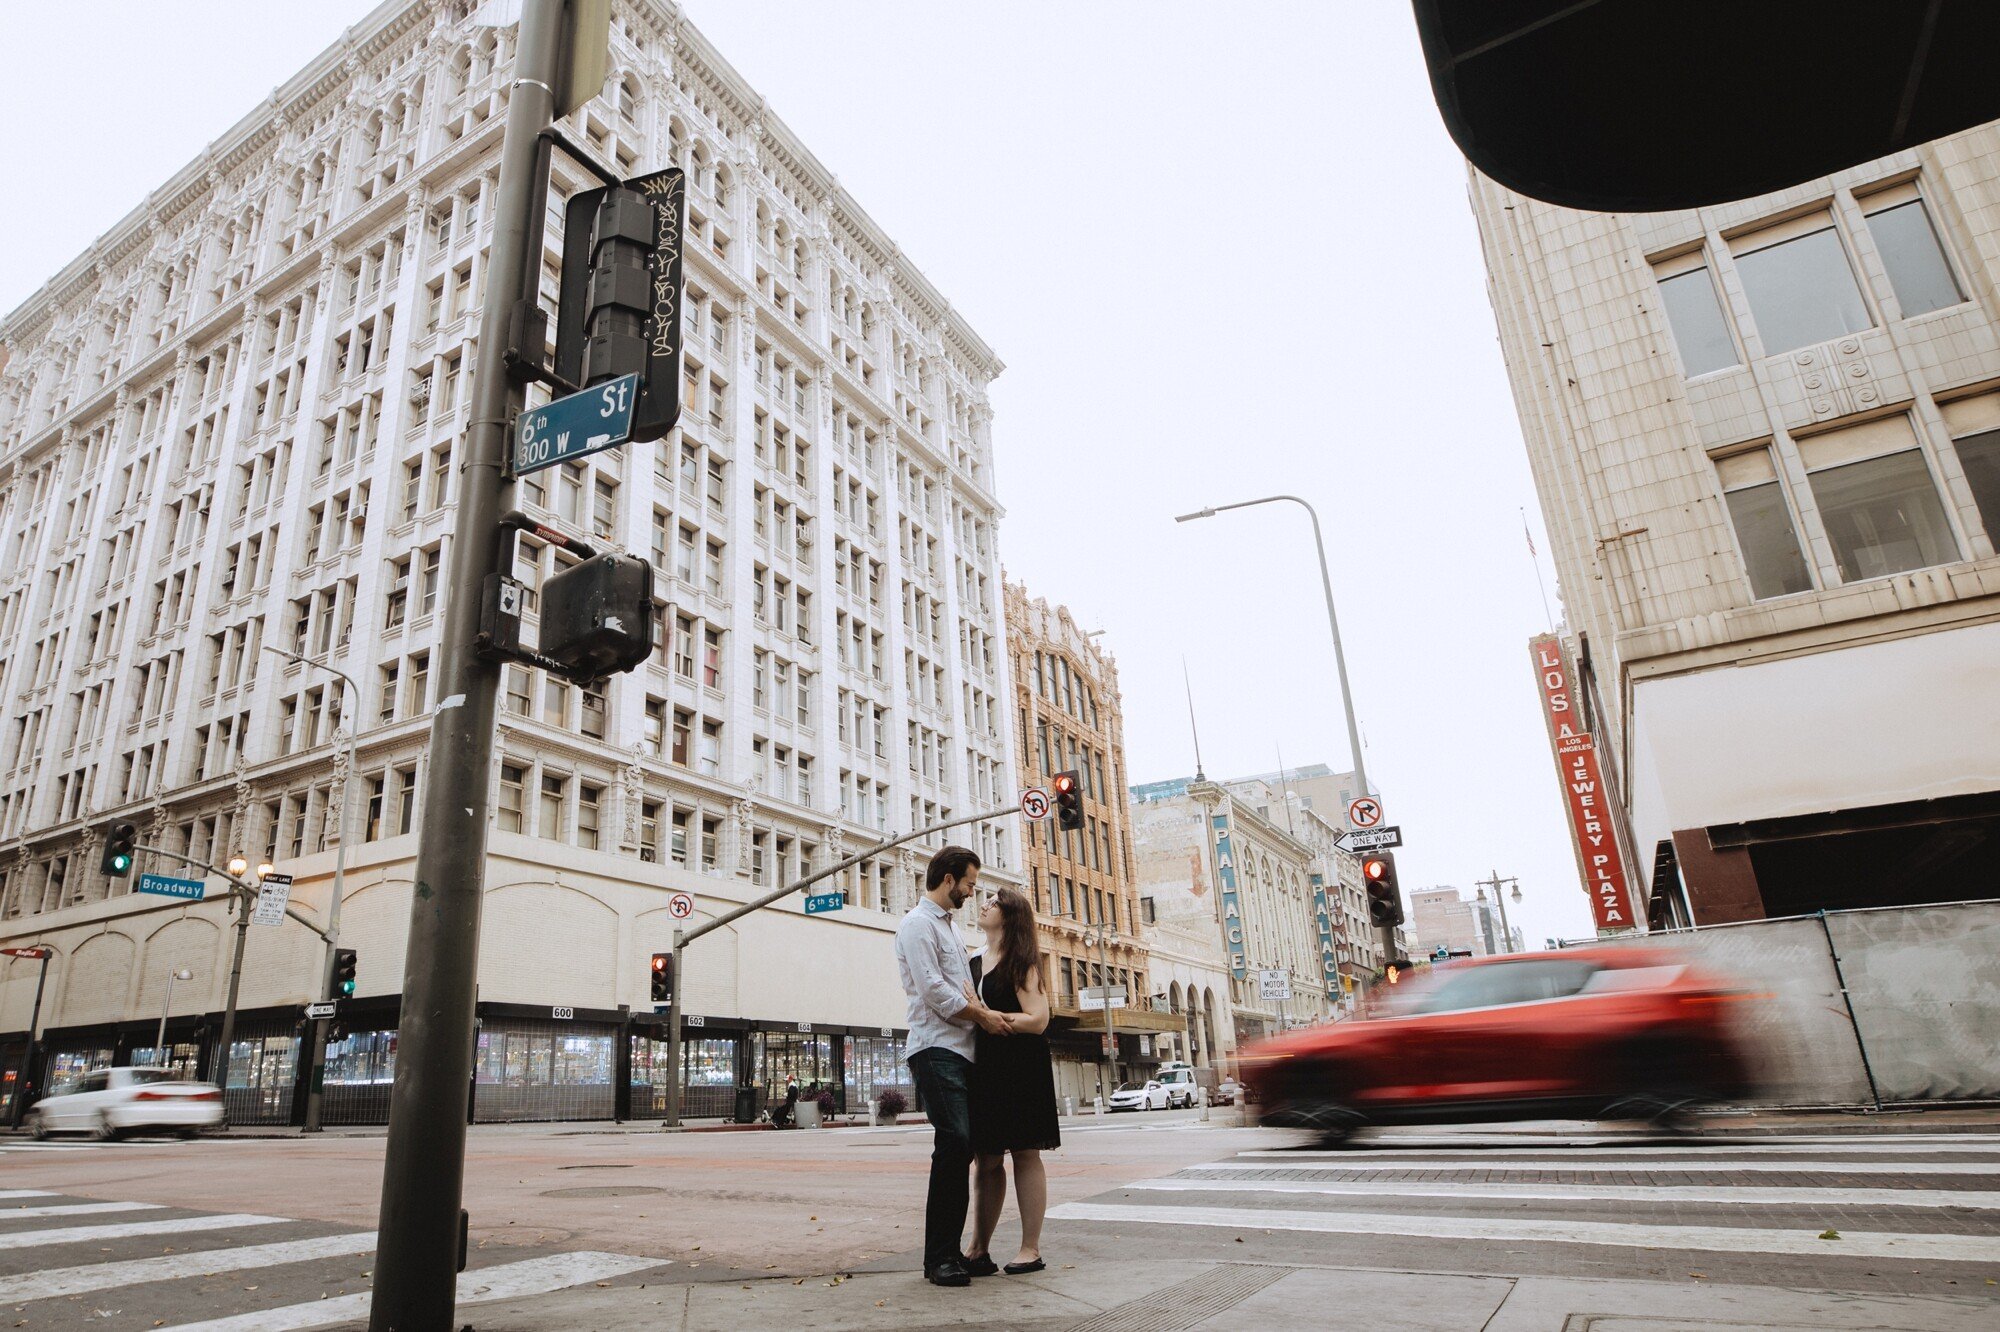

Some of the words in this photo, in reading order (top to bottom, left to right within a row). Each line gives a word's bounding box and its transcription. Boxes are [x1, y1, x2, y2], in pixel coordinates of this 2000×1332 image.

[521, 413, 548, 444] 6th
[600, 381, 628, 418] St
[518, 438, 549, 467] 300
[557, 431, 570, 455] W
[1540, 650, 1569, 713] LOS
[1559, 743, 1592, 754] ANGELES
[1565, 737, 1581, 746] LOS
[1352, 836, 1372, 846] ONE
[1374, 833, 1394, 843] WAY
[1572, 756, 1603, 847] JEWELRY
[1593, 854, 1623, 922] PLAZA
[142, 878, 201, 898] Broadway
[808, 898, 825, 911] 6th
[828, 897, 840, 908] St
[1215, 827, 1245, 970] PALACE
[1312, 884, 1339, 993] PALACE
[1264, 980, 1285, 988] MOTOR
[554, 1008, 572, 1018] 600
[689, 1016, 703, 1026] 602
